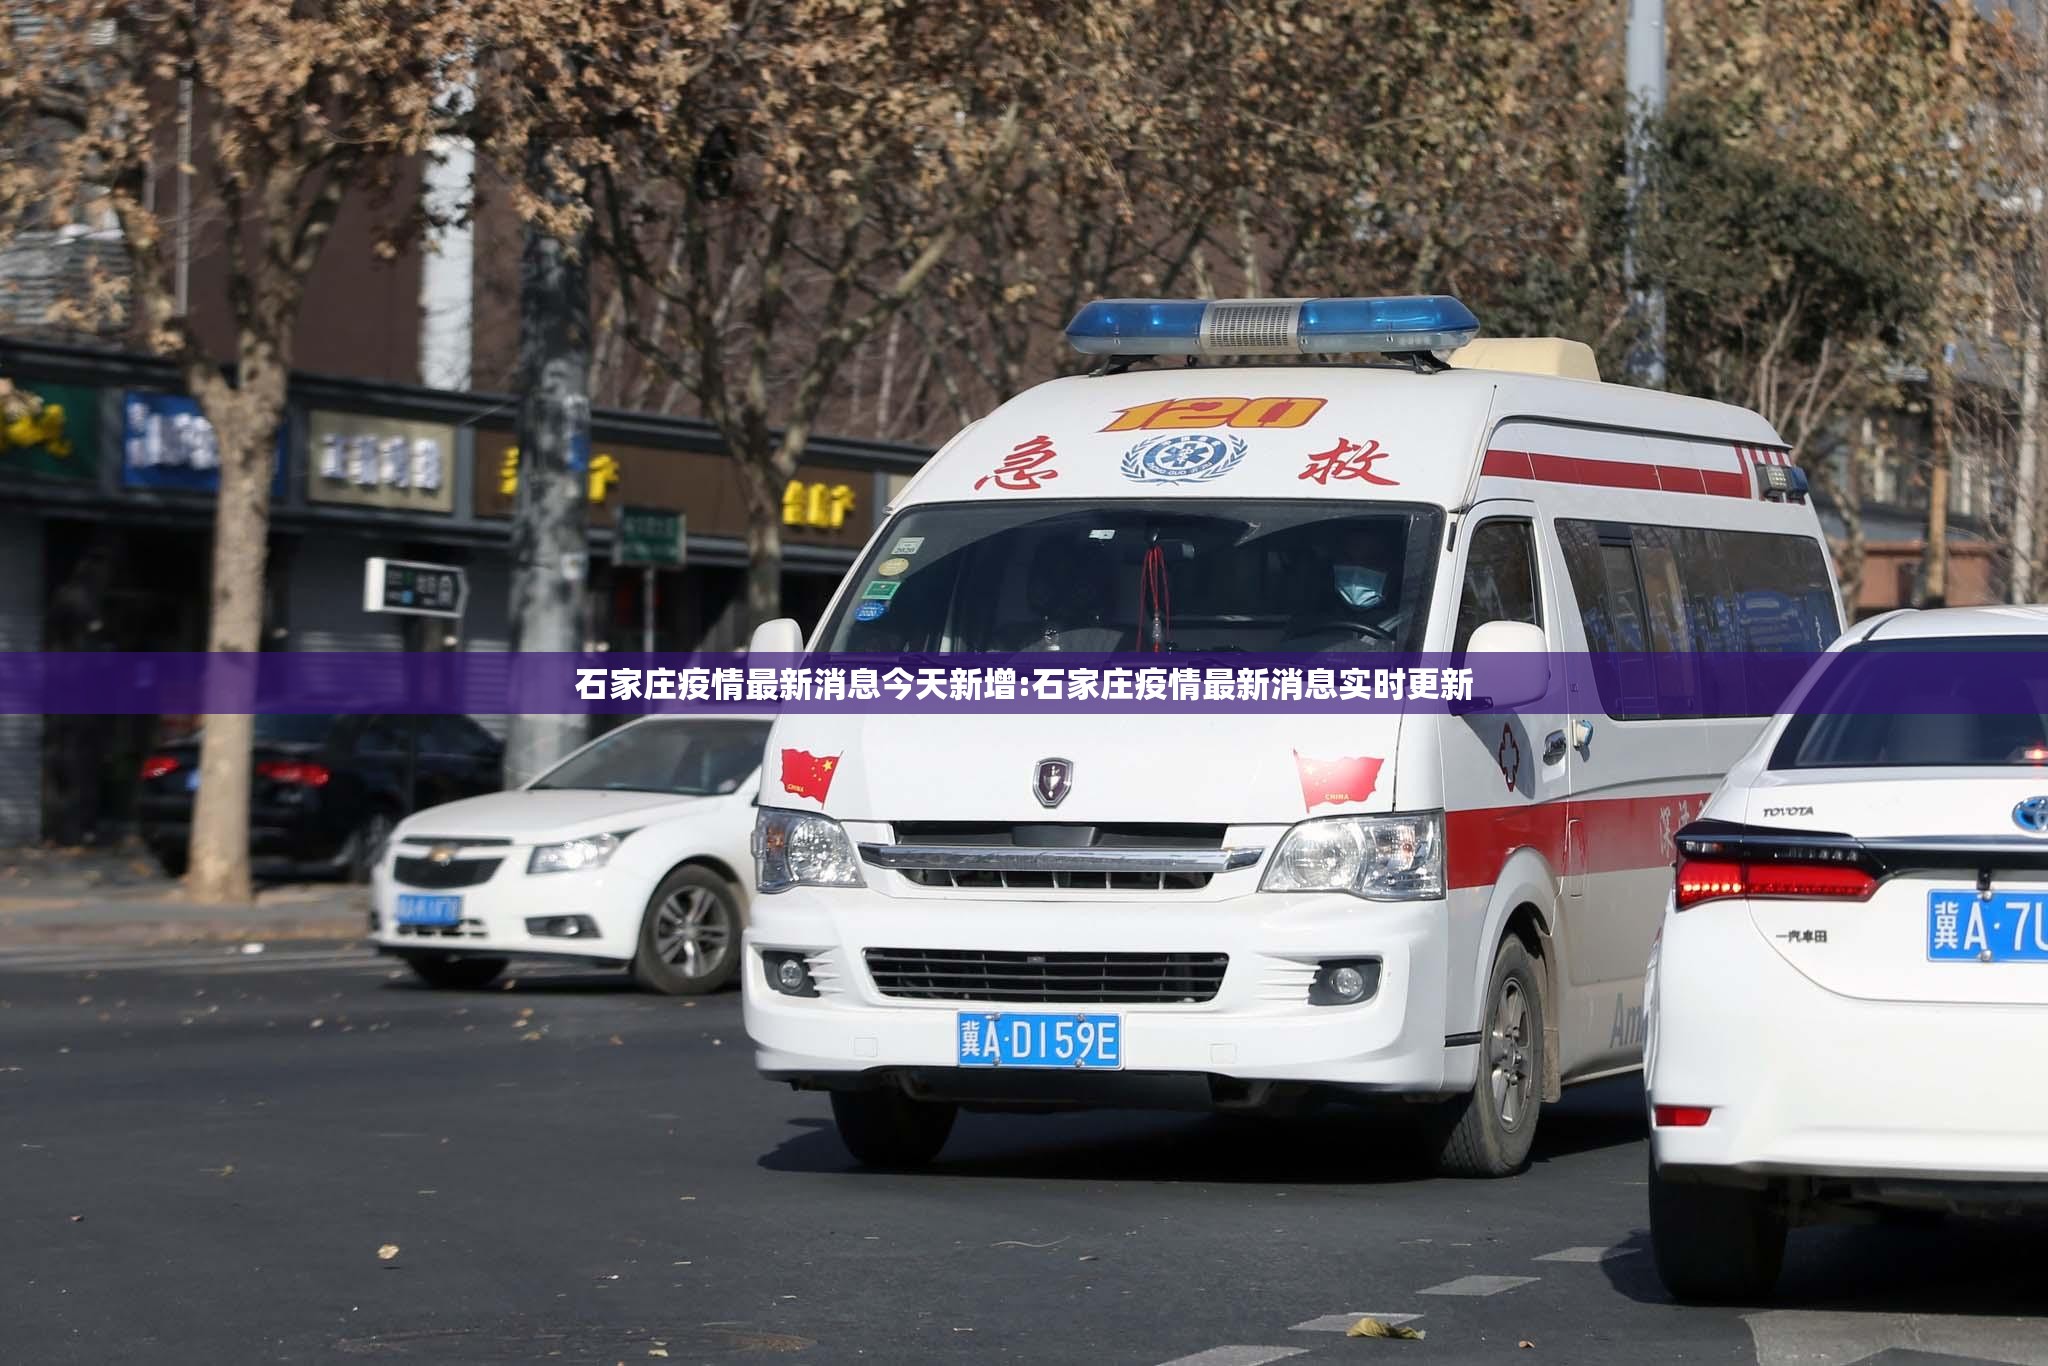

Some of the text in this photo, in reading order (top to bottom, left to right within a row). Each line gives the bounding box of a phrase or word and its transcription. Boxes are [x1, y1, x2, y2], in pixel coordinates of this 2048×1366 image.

[1097, 396, 1328, 432] 120
[974, 435, 1400, 490] 急 救
[1763, 806, 1814, 818] TOYOTA
